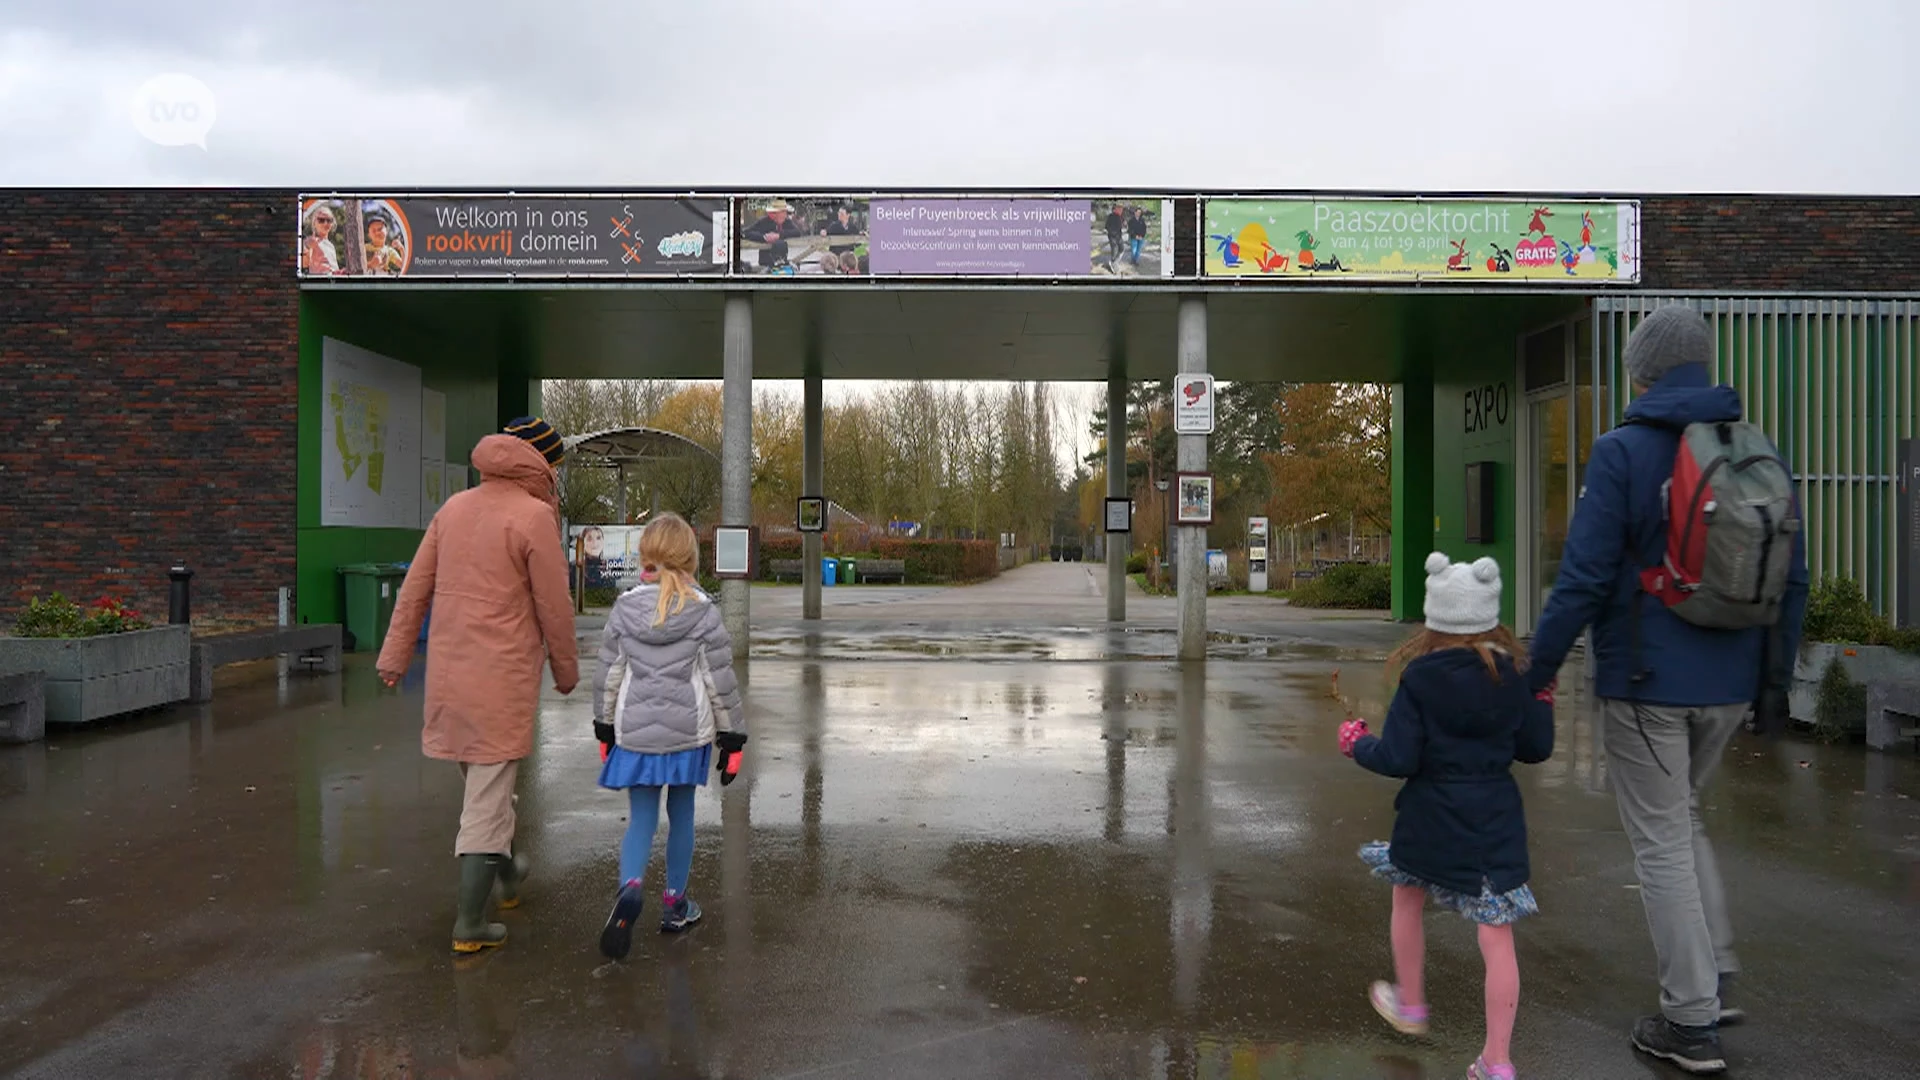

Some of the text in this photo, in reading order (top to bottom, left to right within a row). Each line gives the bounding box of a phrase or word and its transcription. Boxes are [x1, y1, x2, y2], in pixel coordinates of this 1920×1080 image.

[435, 206, 589, 228] Welkom in ons
[876, 207, 1087, 224] Beleef Puyenbroeck als vrijwilliger
[1313, 205, 1511, 233] Paaszoektocht
[948, 227, 976, 238] Spring
[978, 228, 999, 236] eens
[1002, 227, 1031, 236] binnen
[1034, 227, 1042, 236] in
[1045, 227, 1059, 236] het
[426, 230, 597, 256] rookvrij domein
[880, 240, 961, 250] bezoekerscentrum
[963, 241, 975, 250] en
[977, 240, 996, 250] kom
[998, 241, 1019, 250] even
[1331, 235, 1449, 253] van 4 tot 19 april
[414, 257, 437, 266] Roken
[438, 258, 448, 266] en
[449, 258, 471, 267] vapen
[481, 257, 502, 266] enkel
[503, 257, 547, 267] toegestaan
[549, 257, 556, 266] in
[557, 257, 567, 266] de
[568, 257, 609, 266] rookzones
[1515, 247, 1557, 260] GRATIS
[1464, 382, 1508, 433] EXPO
